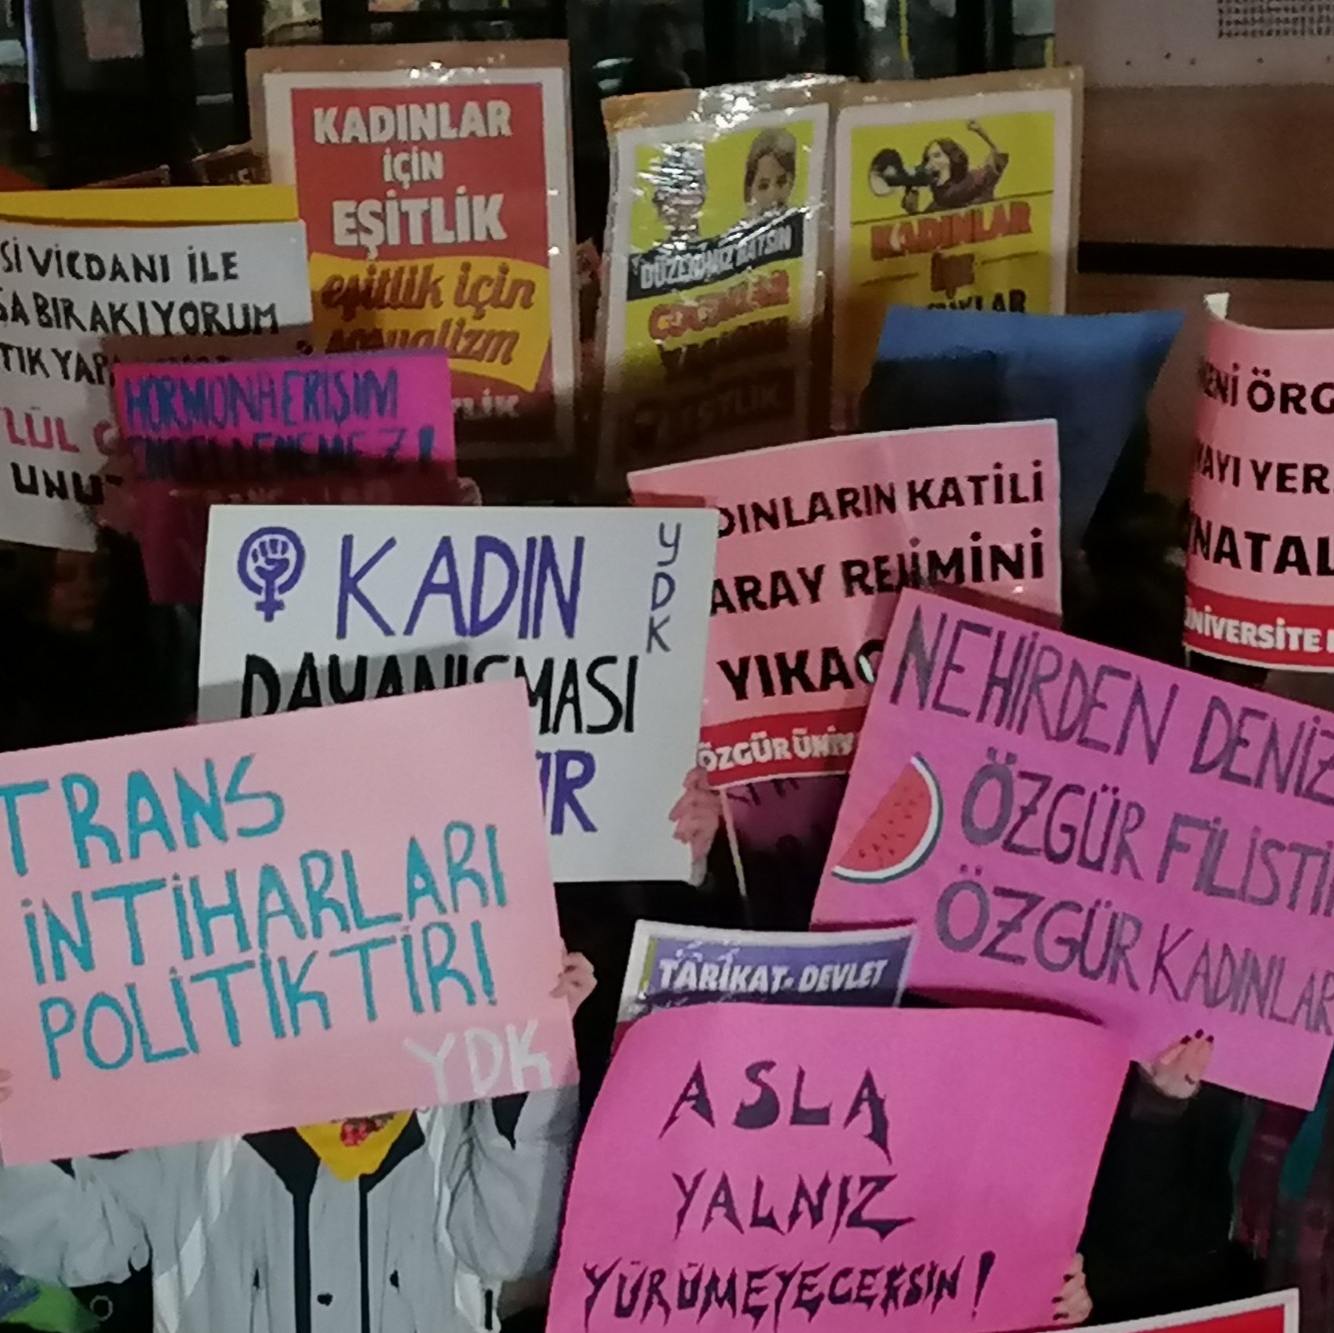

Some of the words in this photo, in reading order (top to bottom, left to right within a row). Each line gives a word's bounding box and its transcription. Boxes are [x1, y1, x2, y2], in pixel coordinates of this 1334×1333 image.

[313, 100, 512, 144] KADINLAR
[383, 146, 444, 189] İÇİN
[332, 186, 507, 260] EŞİTLİK
[28, 244, 171, 284] VİCDANI
[187, 246, 239, 283] İLE
[907, 459, 1043, 508] KATİLİ
[336, 534, 585, 640] KADIN
[709, 564, 825, 616] ARAY
[889, 604, 1179, 765] NEHİRDEN
[697, 729, 791, 772] ÖZGÜR
[961, 746, 1147, 881] ÖZGÜR
[20, 820, 509, 985] İNTİHARLARI
[936, 865, 1143, 992] ÖZGÜR
[798, 959, 889, 992] DEVLET
[404, 1019, 553, 1102] YDK
[658, 1060, 892, 1165] ASLA
[671, 1168, 916, 1242] YALNIZ
